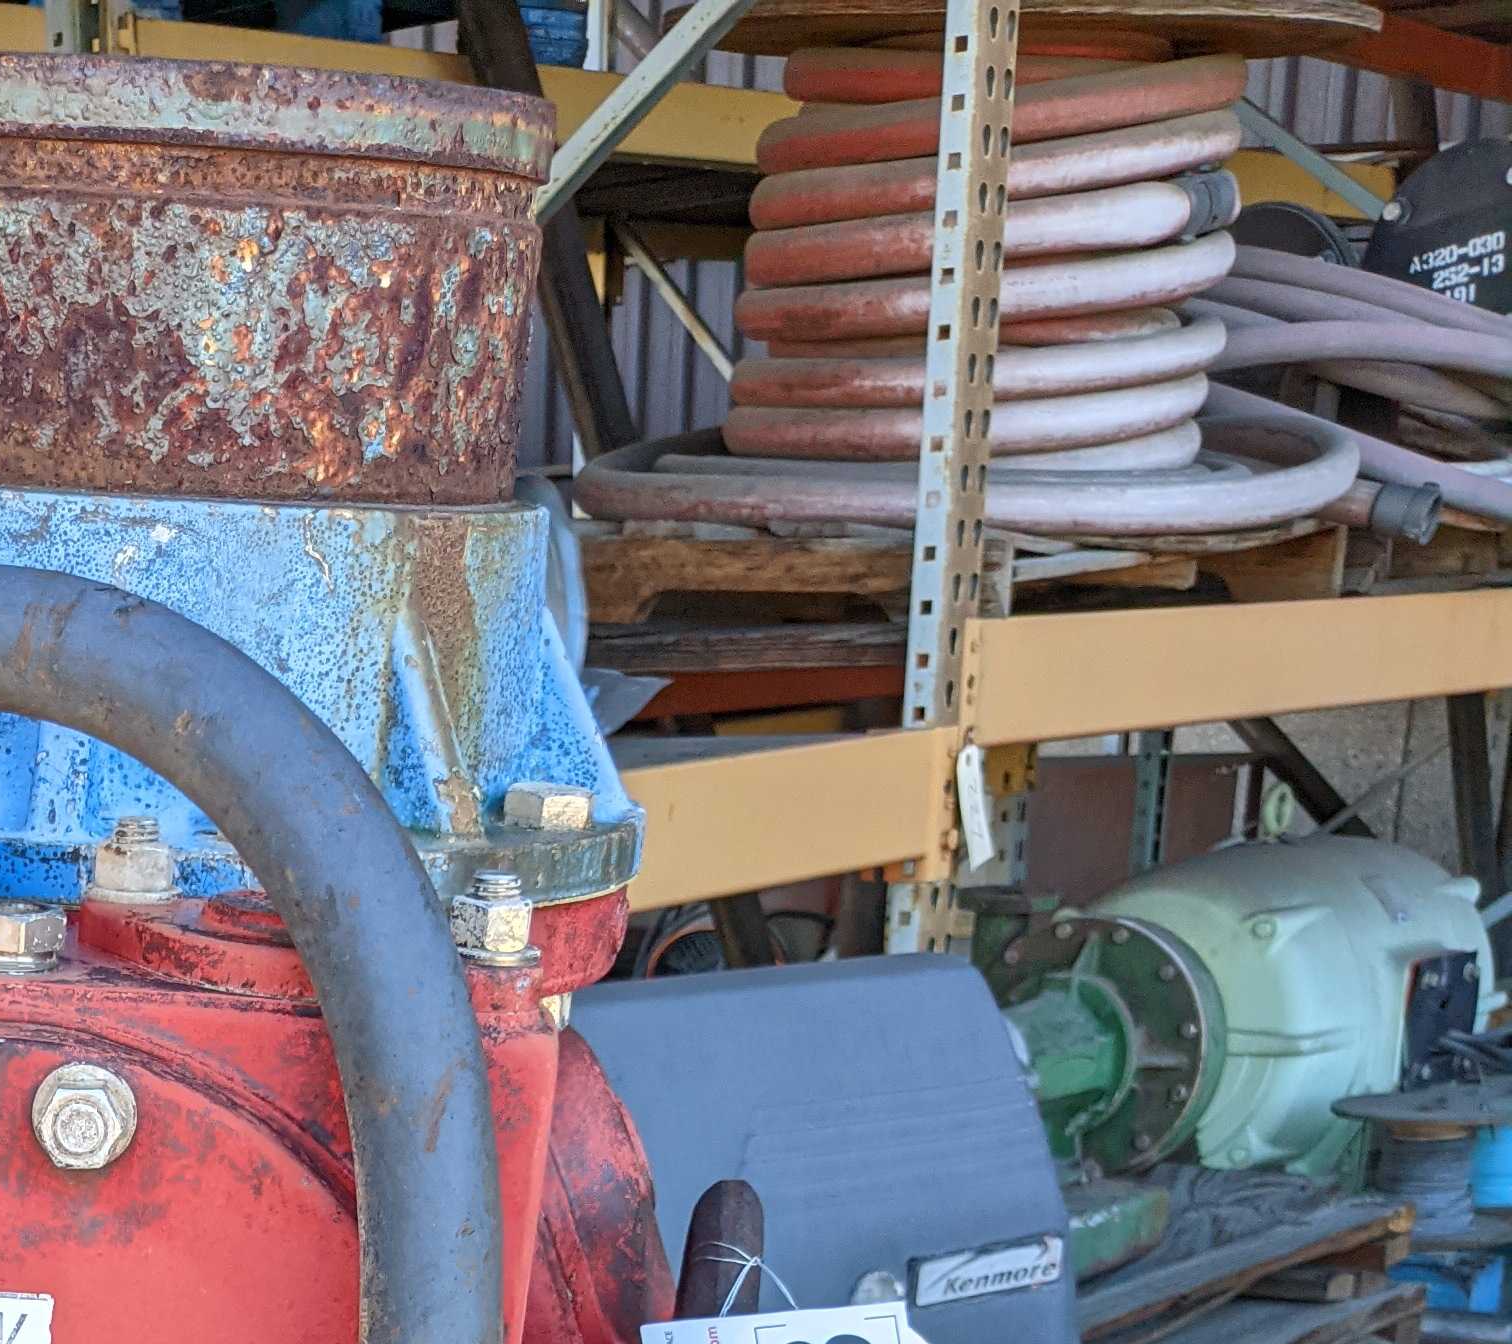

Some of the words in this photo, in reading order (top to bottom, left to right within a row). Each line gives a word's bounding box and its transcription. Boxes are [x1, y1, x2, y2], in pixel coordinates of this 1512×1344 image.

[1409, 231, 1505, 274] A320-030
[1432, 253, 1505, 290] 252-13
[943, 1262, 1057, 1297] Kenmore
